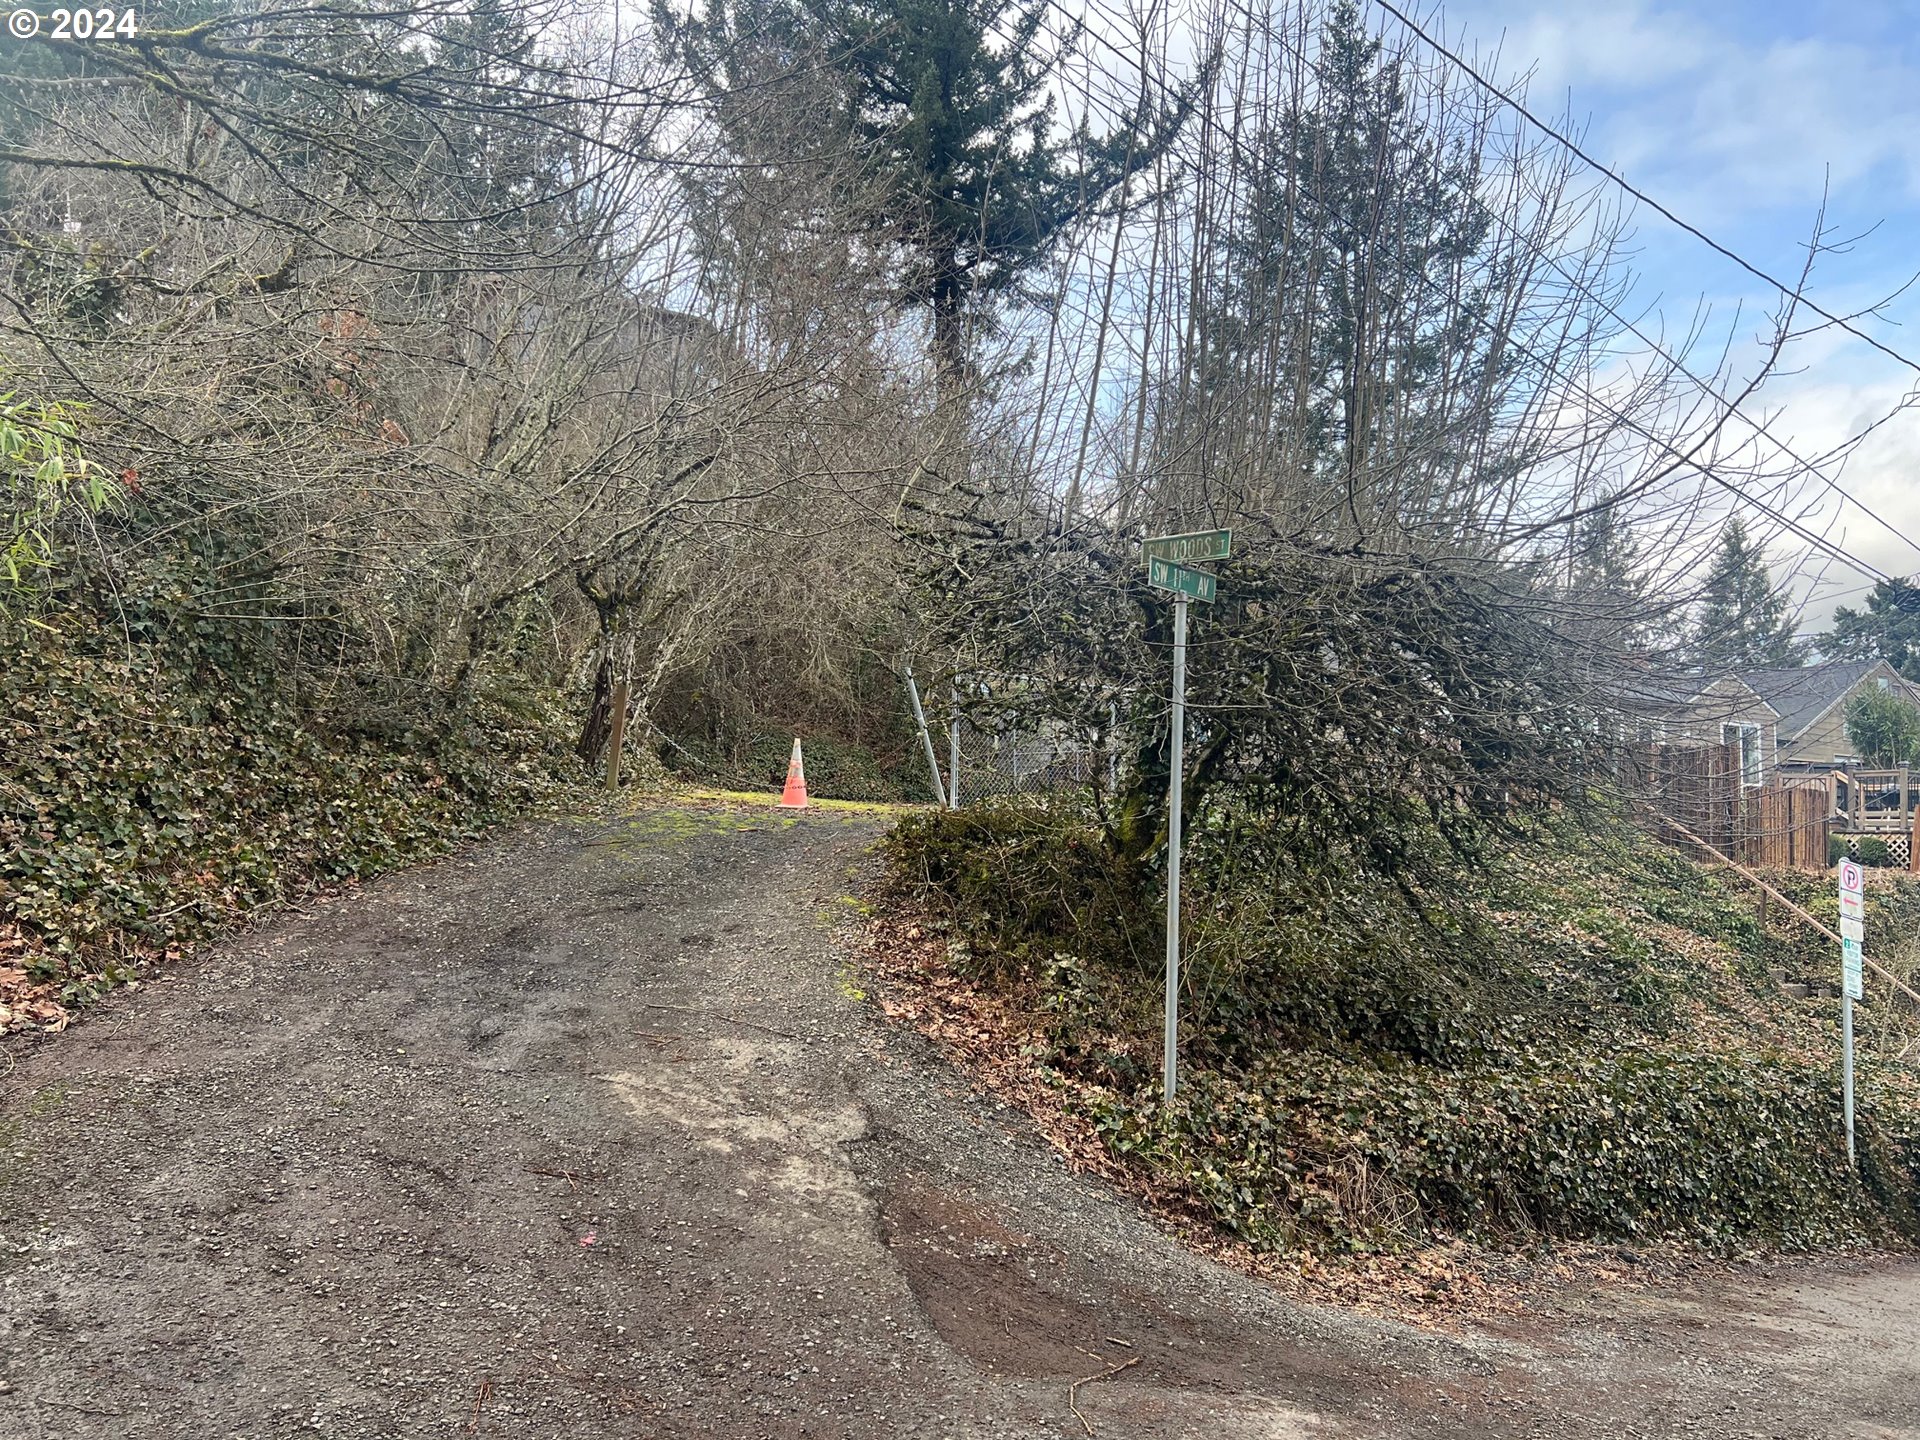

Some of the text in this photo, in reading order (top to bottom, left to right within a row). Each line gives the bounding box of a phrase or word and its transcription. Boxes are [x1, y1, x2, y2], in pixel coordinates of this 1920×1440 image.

[1169, 536, 1212, 560] WOODS
[1154, 562, 1169, 583] SW
[1197, 576, 1210, 596] AV
